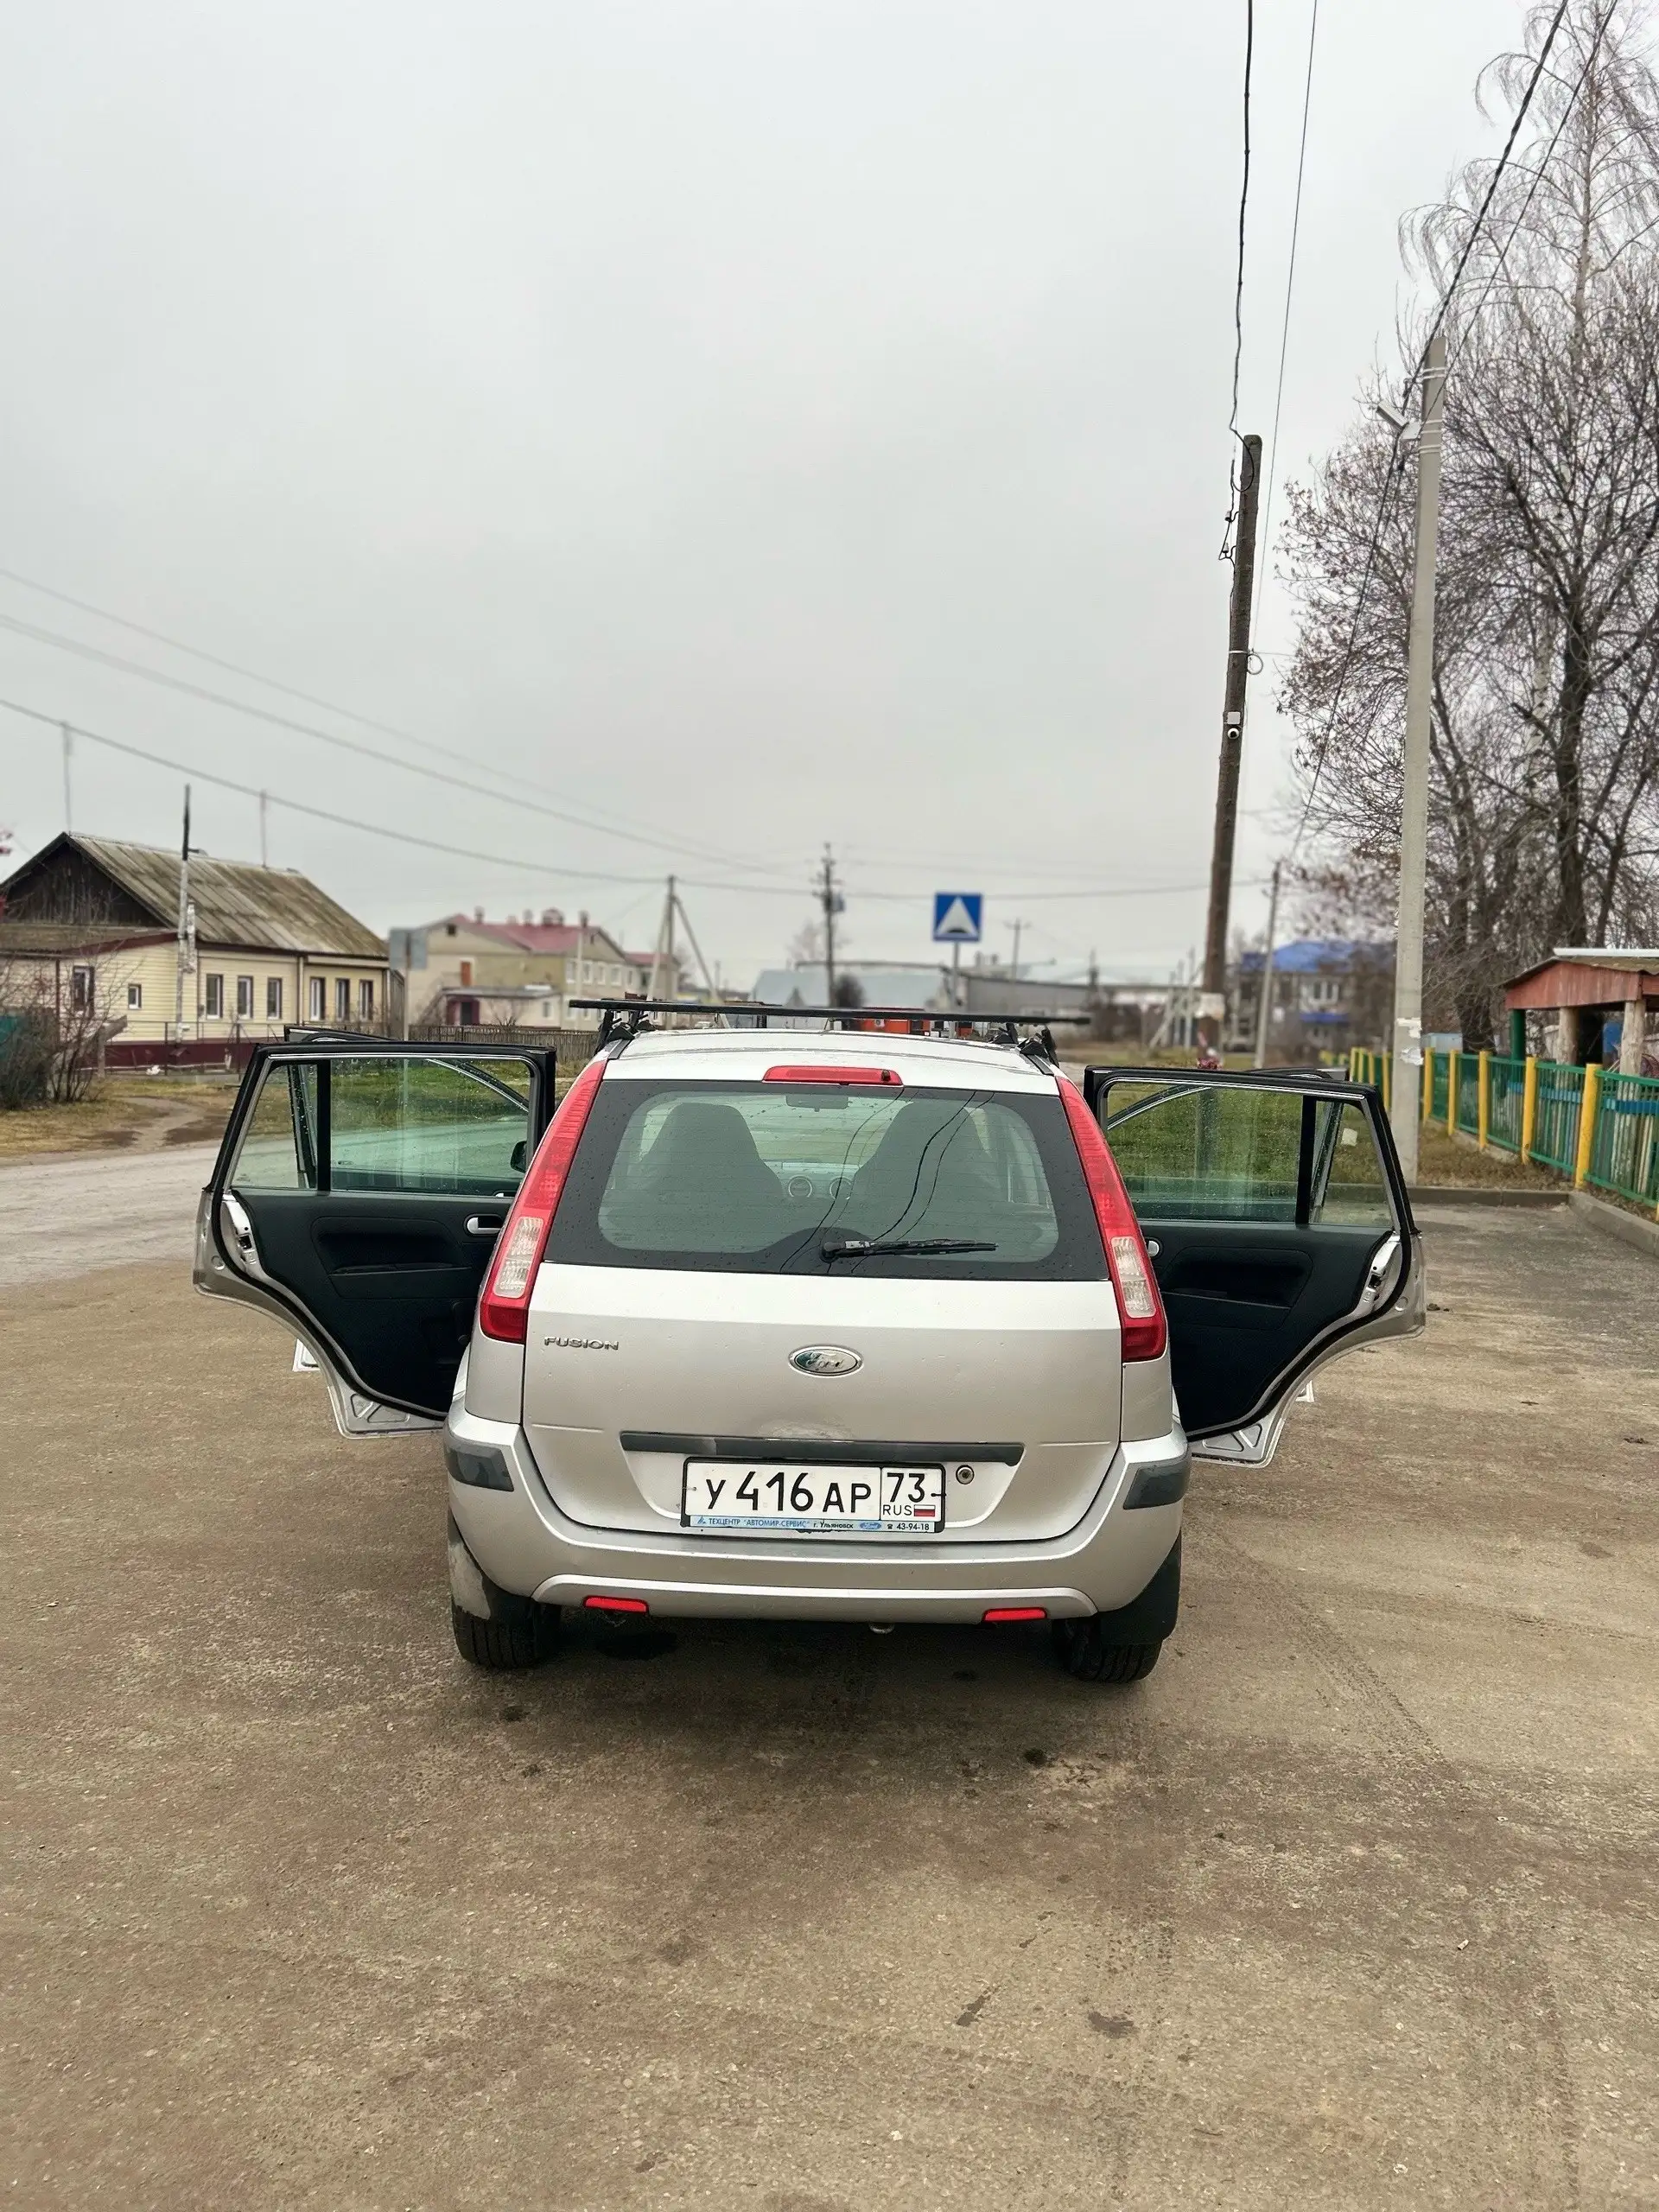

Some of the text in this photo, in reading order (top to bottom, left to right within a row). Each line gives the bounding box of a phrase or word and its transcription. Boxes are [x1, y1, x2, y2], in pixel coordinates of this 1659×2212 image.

[543, 1337, 619, 1350] FUSION
[887, 1472, 925, 1503] 73
[882, 1504, 912, 1516] RUS
